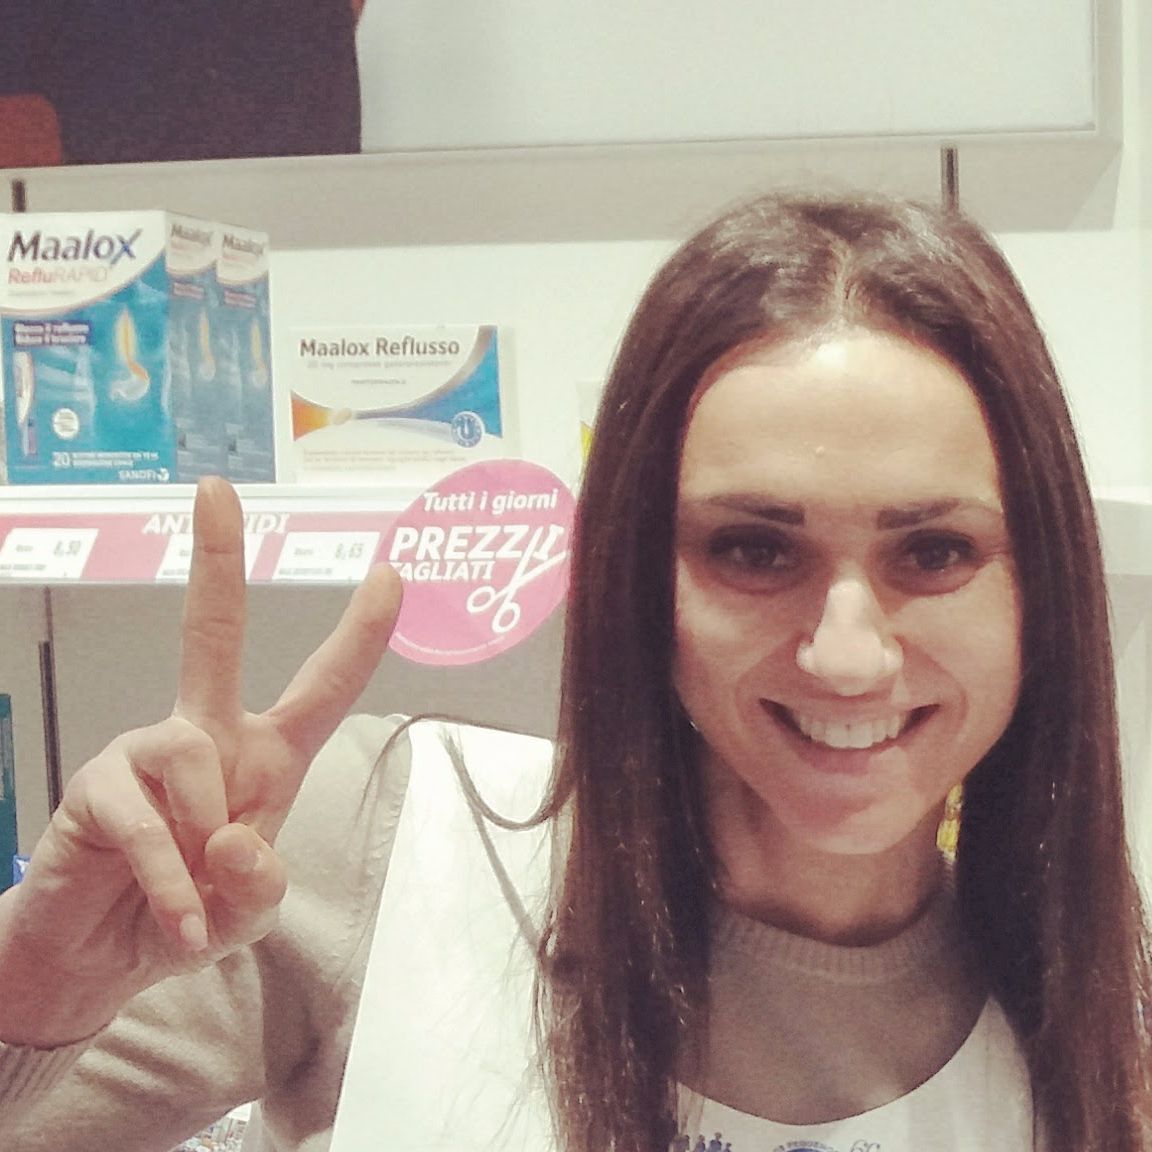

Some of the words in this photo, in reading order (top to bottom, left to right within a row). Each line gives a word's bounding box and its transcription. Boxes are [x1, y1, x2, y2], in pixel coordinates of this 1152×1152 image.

[8, 228, 142, 264] Maalox
[299, 338, 369, 357] Maalox
[375, 336, 460, 356] Reflusso
[423, 491, 475, 512] Tutti
[480, 491, 489, 511] i
[491, 488, 559, 516] giorni
[389, 524, 565, 561] PREZZI
